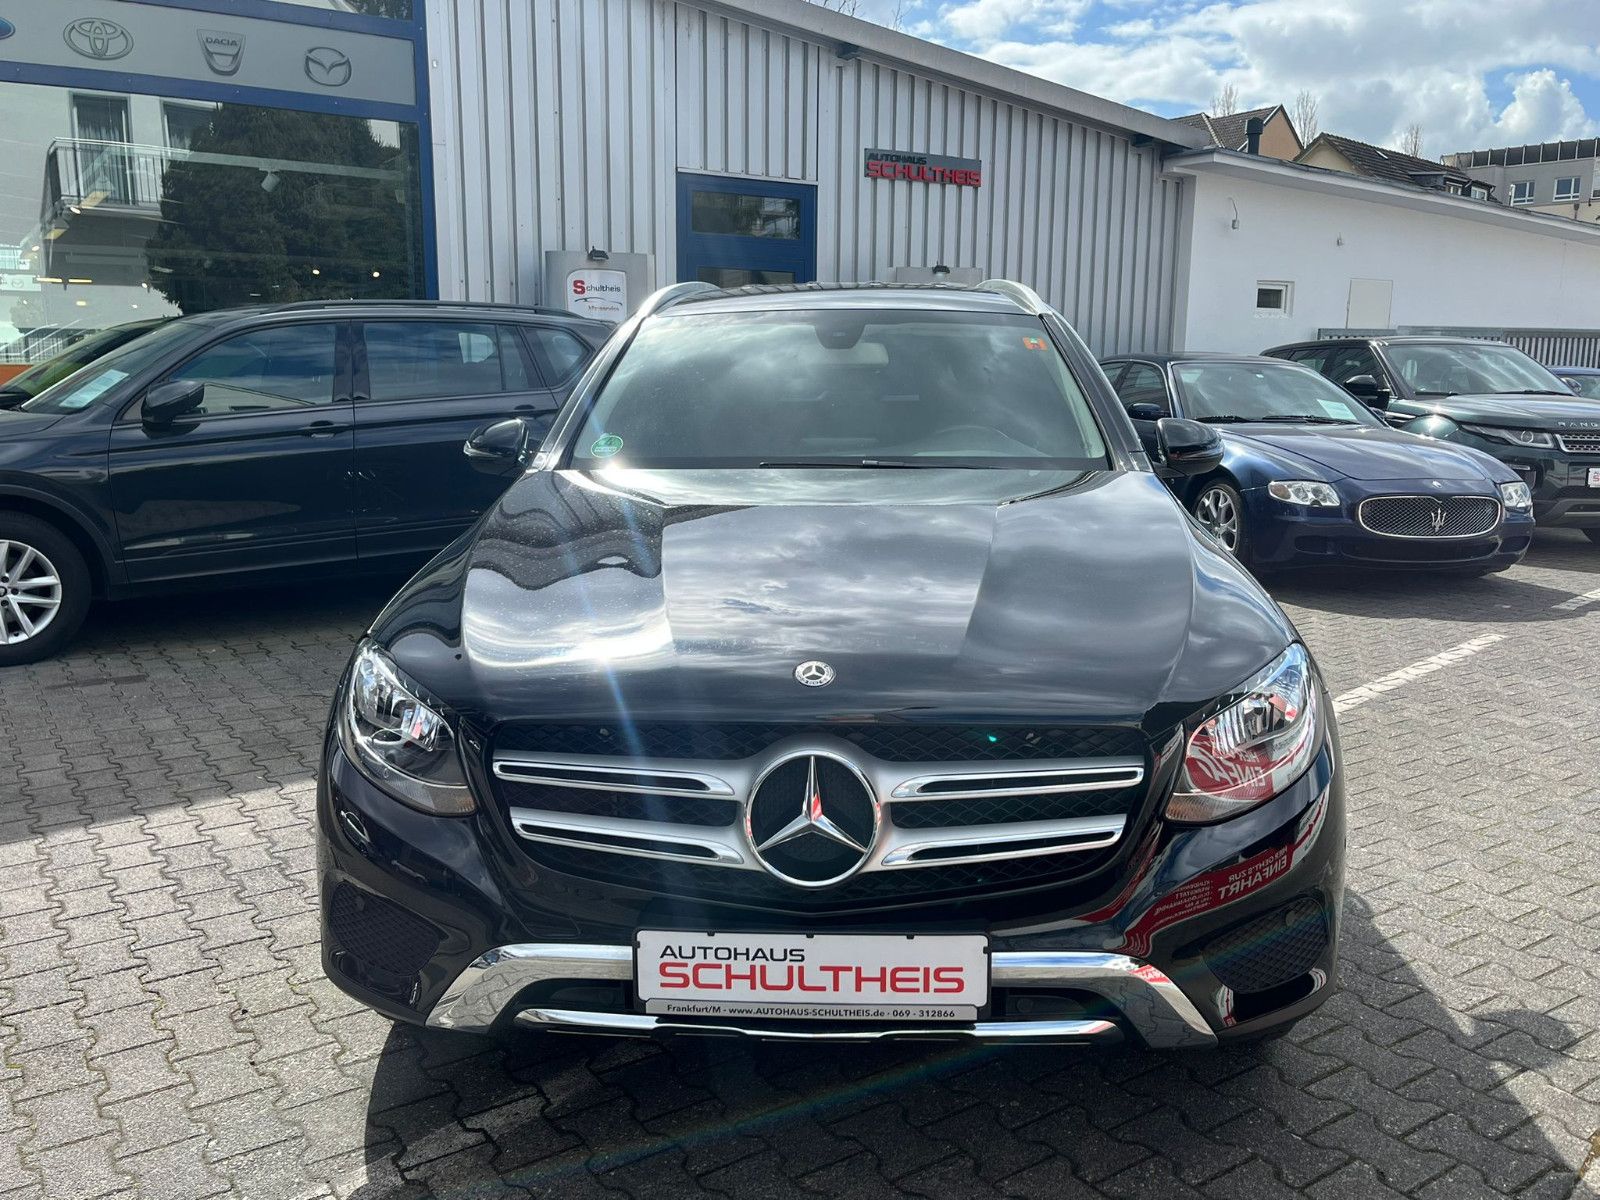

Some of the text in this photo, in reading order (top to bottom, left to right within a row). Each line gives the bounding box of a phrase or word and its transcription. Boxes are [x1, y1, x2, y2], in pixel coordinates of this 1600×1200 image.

[206, 37, 238, 46] DACIA
[868, 152, 927, 165] AUTOHAUS
[866, 160, 982, 187] SCHULTHEIS
[573, 279, 621, 295] Schultheis
[659, 945, 805, 962] AUTOHAUS
[658, 961, 965, 993] SCHULTHEIS
[667, 1003, 721, 1014] Frankfurt/M
[729, 1007, 885, 1017] www.AUTOHAUS-SCHULTHEIS.de
[892, 1009, 910, 1017] 069
[919, 1010, 955, 1018] 312866
